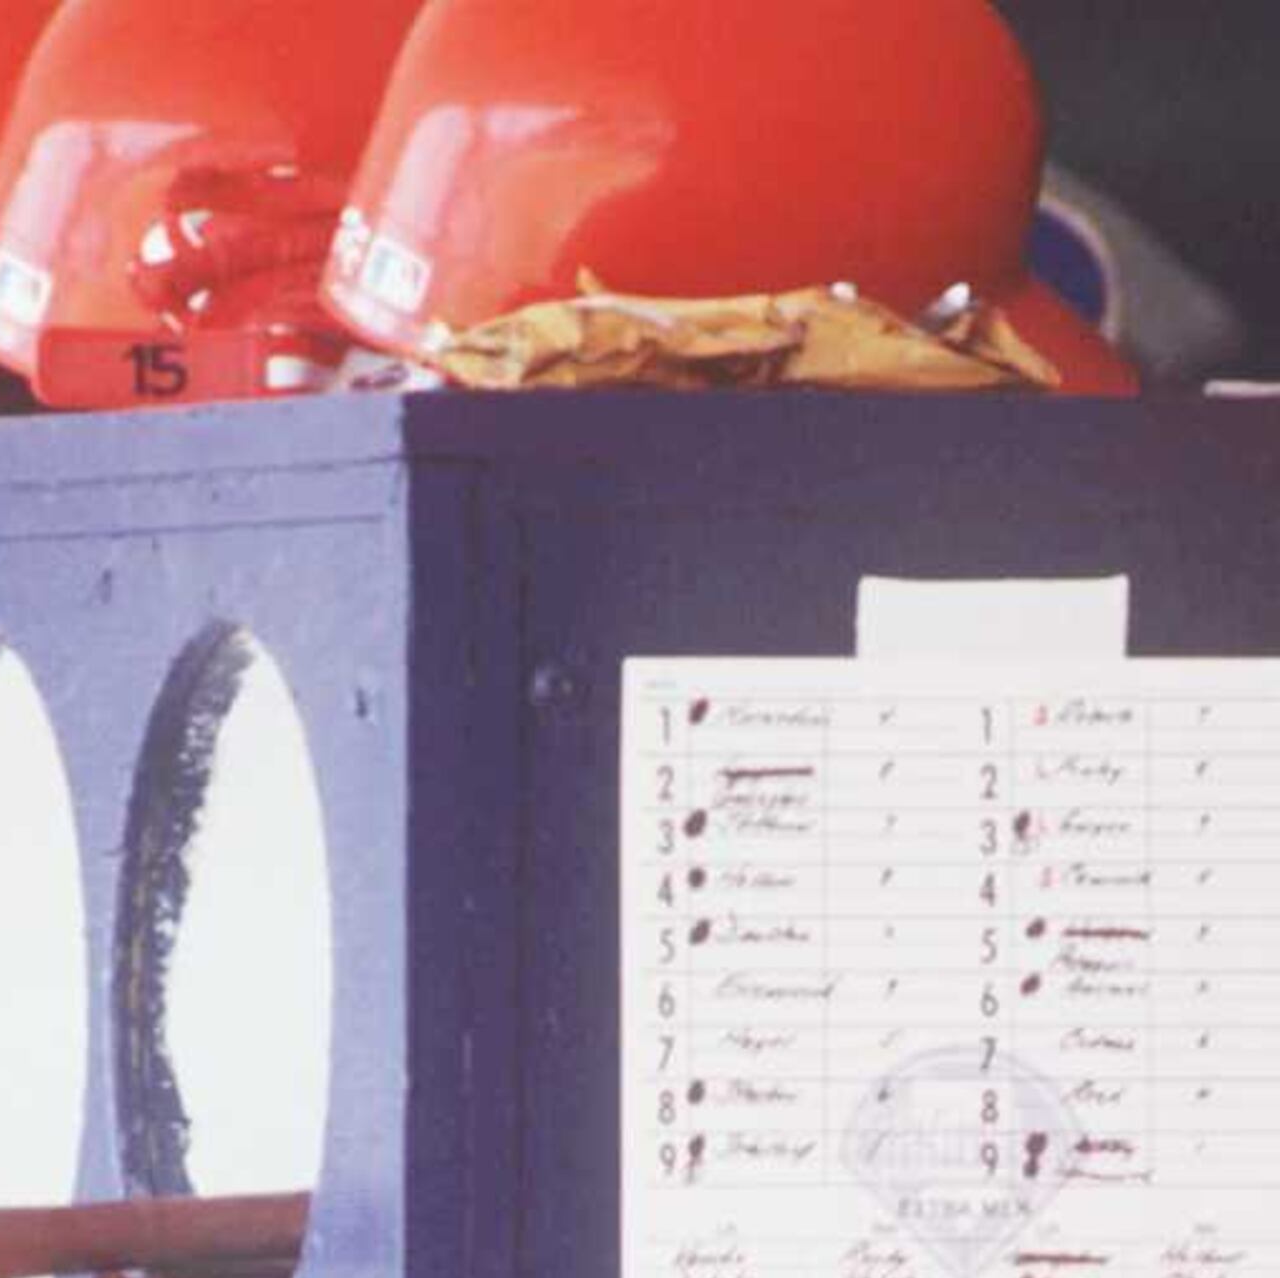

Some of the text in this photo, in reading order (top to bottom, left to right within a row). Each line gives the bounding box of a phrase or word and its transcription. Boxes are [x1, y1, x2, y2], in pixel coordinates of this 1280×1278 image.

[124, 342, 188, 399] 15
[661, 706, 672, 745] 1
[981, 706, 993, 745] 1
[657, 765, 675, 801] 2
[980, 763, 998, 800] 2
[657, 820, 675, 855] 3
[979, 819, 998, 855] 3
[656, 874, 674, 907] 4
[979, 873, 996, 908] 4
[659, 927, 676, 964] 5
[980, 928, 998, 964] 5
[657, 982, 676, 1019] 6
[979, 982, 999, 1018] 6
[658, 1036, 676, 1072] 7
[980, 1036, 997, 1073] 7
[657, 1089, 676, 1126] 8
[980, 1088, 1000, 1124] 8
[658, 1142, 676, 1177] 9
[980, 1142, 999, 1177] 9
